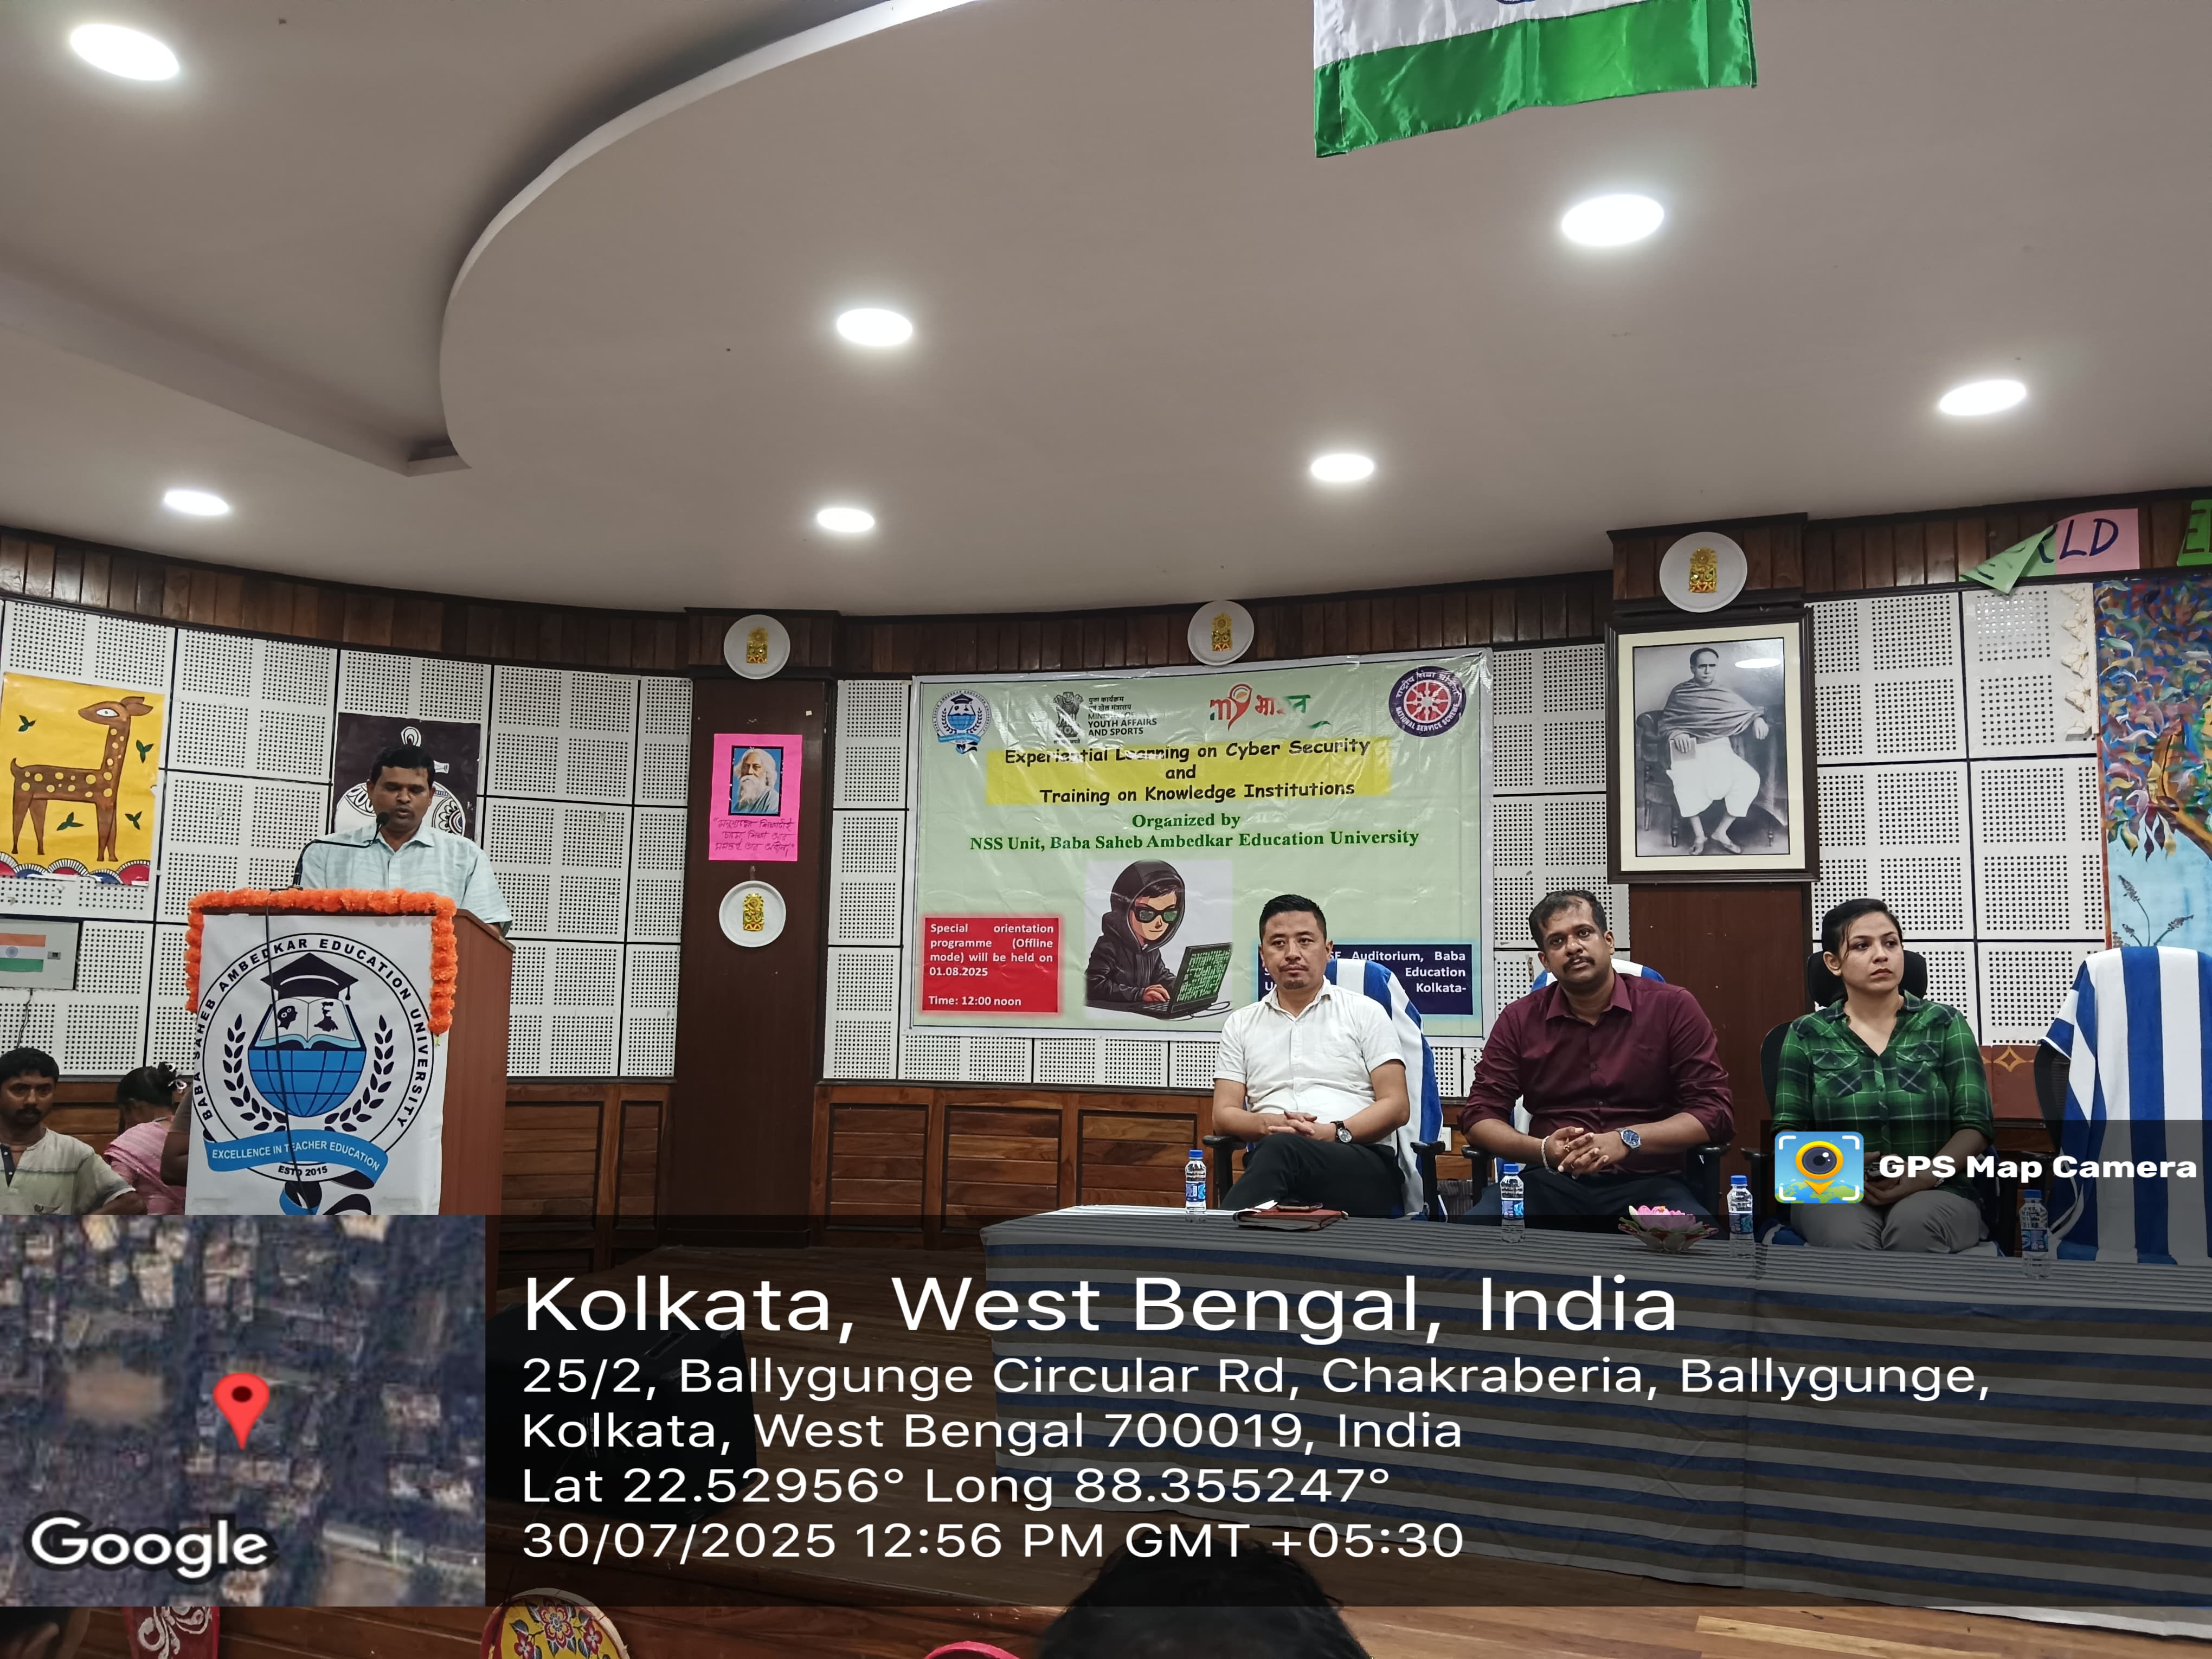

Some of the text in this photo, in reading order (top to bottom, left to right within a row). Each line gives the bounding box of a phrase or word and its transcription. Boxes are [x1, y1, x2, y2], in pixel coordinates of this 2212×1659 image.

[1088, 712, 1121, 720] MINIS
[1396, 703, 1459, 731] NATIONAL SERVICE SCHEME
[1088, 718, 1157, 728] YOUTH AFFAIRS
[1110, 727, 1143, 736] SPORTS
[1198, 747, 1217, 757] on
[1226, 742, 1280, 760] Cyber
[1289, 738, 1370, 755] Security
[1166, 764, 1196, 779] and
[1040, 782, 1355, 806] Training on Knowledge Institutions
[1131, 813, 1240, 830] Organized by
[970, 829, 1419, 852] NSS Unit, Baba Saheb Ambedkar Education University
[930, 923, 1054, 934] Special orientation
[930, 938, 1053, 949] programme (Offline
[930, 952, 964, 963] mode)
[968, 953, 988, 962] will
[993, 953, 1006, 962] be
[1011, 953, 1034, 962] held
[1352, 950, 1424, 962] Auditorium,
[1435, 951, 1465, 961] Baba
[929, 967, 988, 976] 01.08.2025
[1405, 967, 1465, 977] Education
[1416, 982, 1467, 993] Kolkata-
[928, 995, 1022, 1006] Time: 12:00 noon
[193, 938, 428, 1128] BABA SAHEB AMBEDKAR EDUCATION UNIVERSITY
[212, 1140, 380, 1171] EXCELLENCE IN TEACHER EDUCATION
[278, 1165, 328, 1176] ESTD 2015
